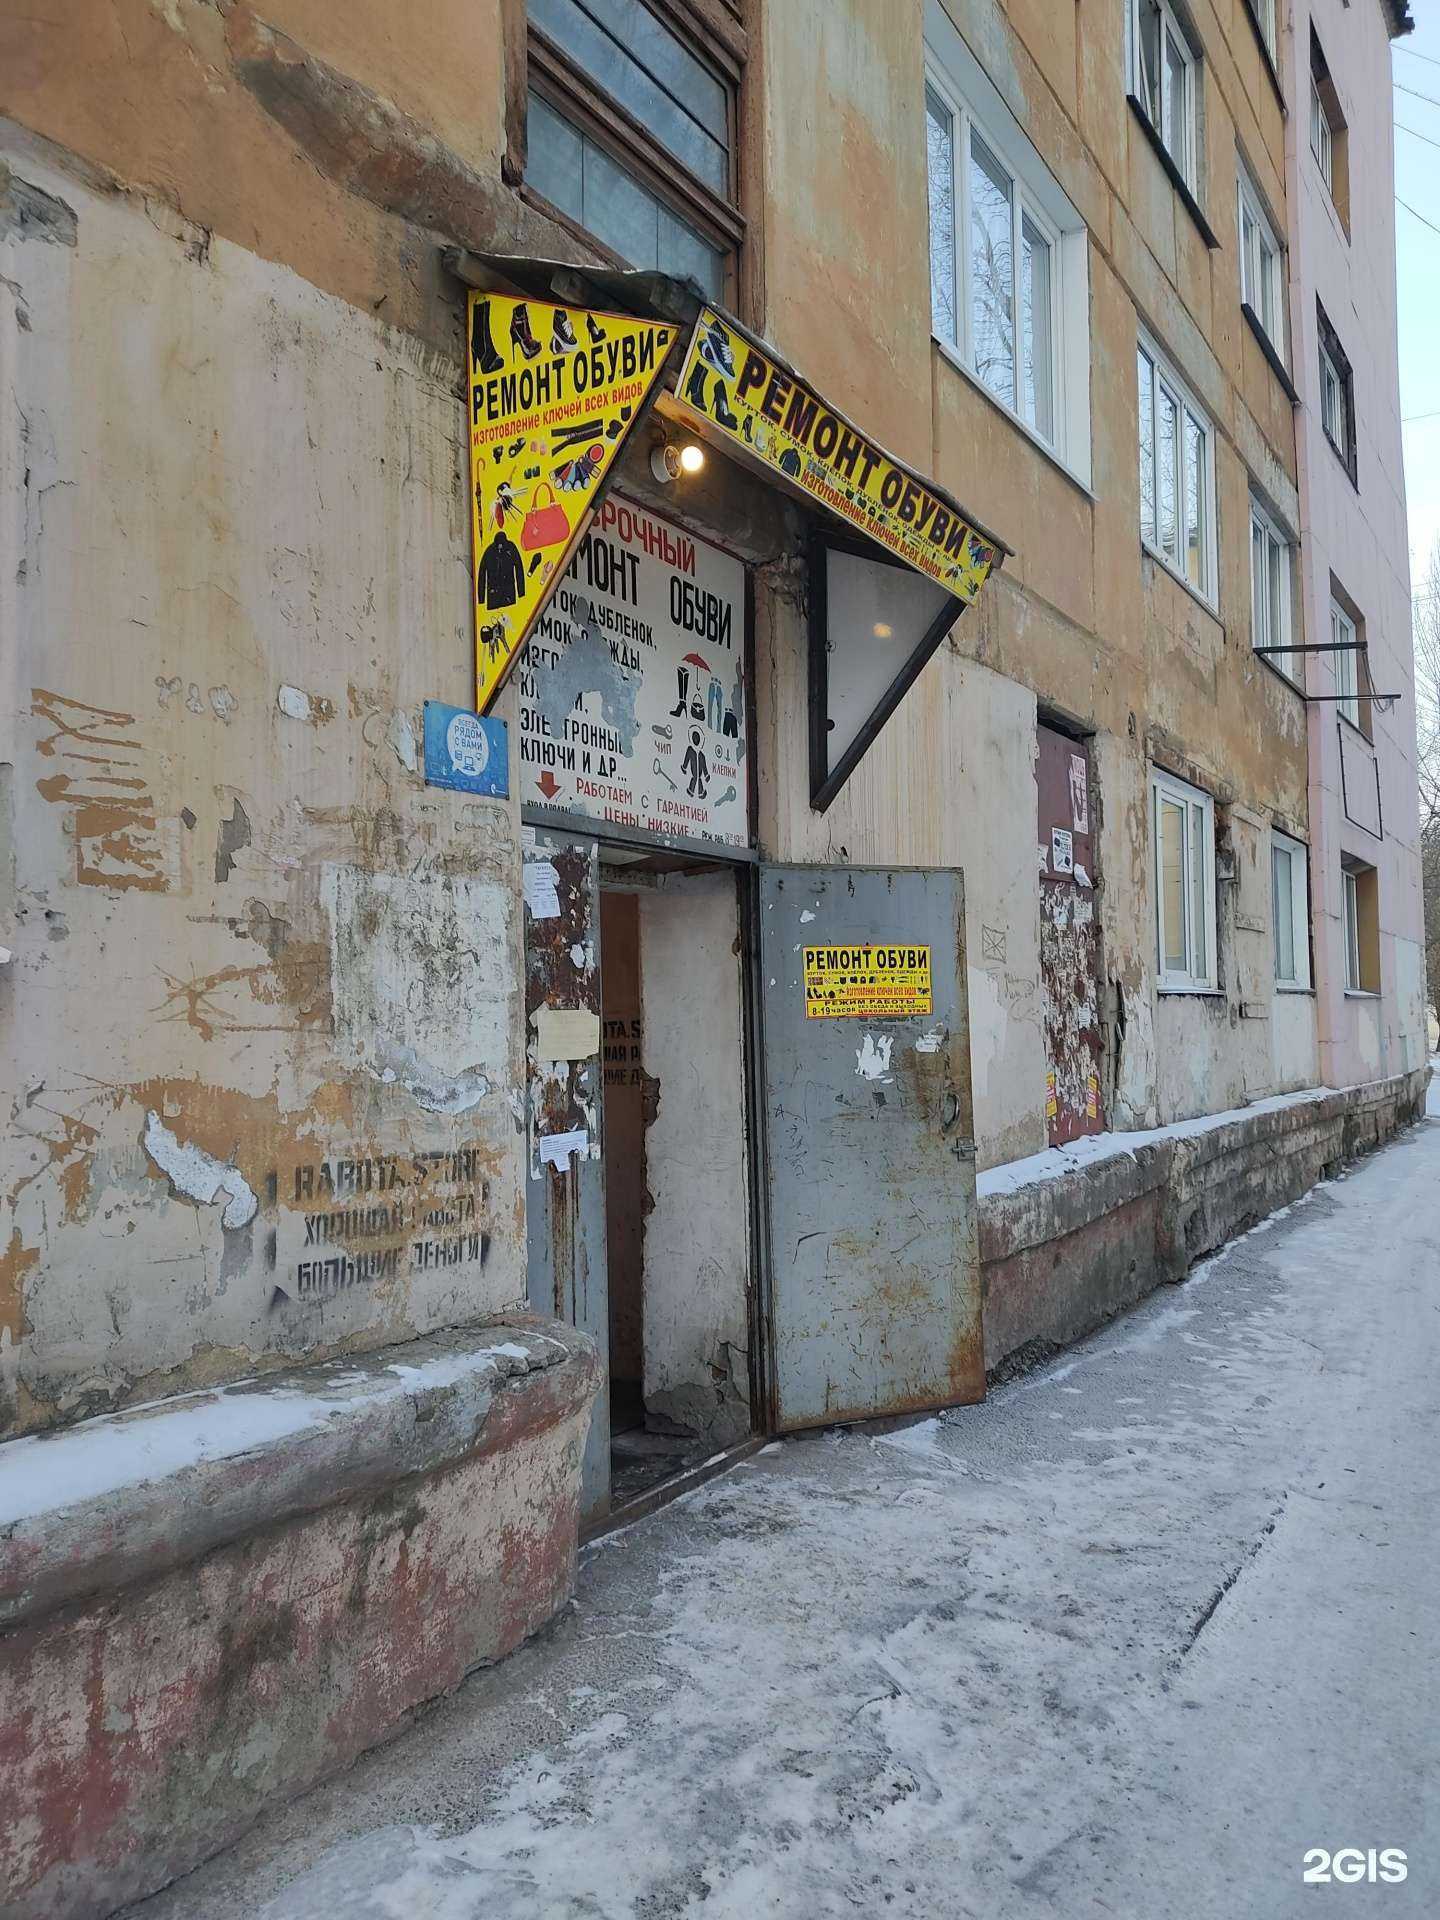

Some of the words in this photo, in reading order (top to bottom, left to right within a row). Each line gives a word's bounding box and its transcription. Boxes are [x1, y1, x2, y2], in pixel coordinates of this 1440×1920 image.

[473, 358, 565, 425] РЕМОНТ
[573, 328, 654, 394] ОБУВИ
[473, 412, 540, 447] изготовление
[543, 396, 582, 424] ключей
[585, 391, 609, 412] всех
[613, 381, 643, 404] видов
[734, 394, 777, 432] КУРТОК,
[736, 350, 881, 490] РЕМОНТ
[880, 469, 968, 560] ОБУВИ
[592, 499, 696, 577] РОЧНЫЙ
[564, 532, 639, 606] МОНТ
[670, 575, 732, 650] ОБУВИ
[534, 615, 572, 645] МОК
[581, 629, 643, 677] ОЖДЫ,
[588, 600, 657, 652] ДУБЛЕНОК,
[454, 726, 482, 740] РЯДОМ
[462, 739, 483, 752] ВАМИ
[520, 707, 624, 755] ЭЛЕТРОННЫ
[654, 740, 672, 755] ЧИП
[520, 736, 575, 771] КЛЮЧИ
[582, 750, 591, 774] И
[712, 762, 737, 779] КЛЕПКИ
[576, 777, 633, 805] РАБОТАЕМ
[641, 795, 649, 809] С
[657, 799, 709, 823] ГАРАНТИЕЙ
[604, 806, 640, 828] ЦЕНЫ
[647, 817, 690, 837] НИЗКИЕ
[806, 950, 872, 970] РЕМОНТ
[876, 949, 927, 969] ОБУВИ
